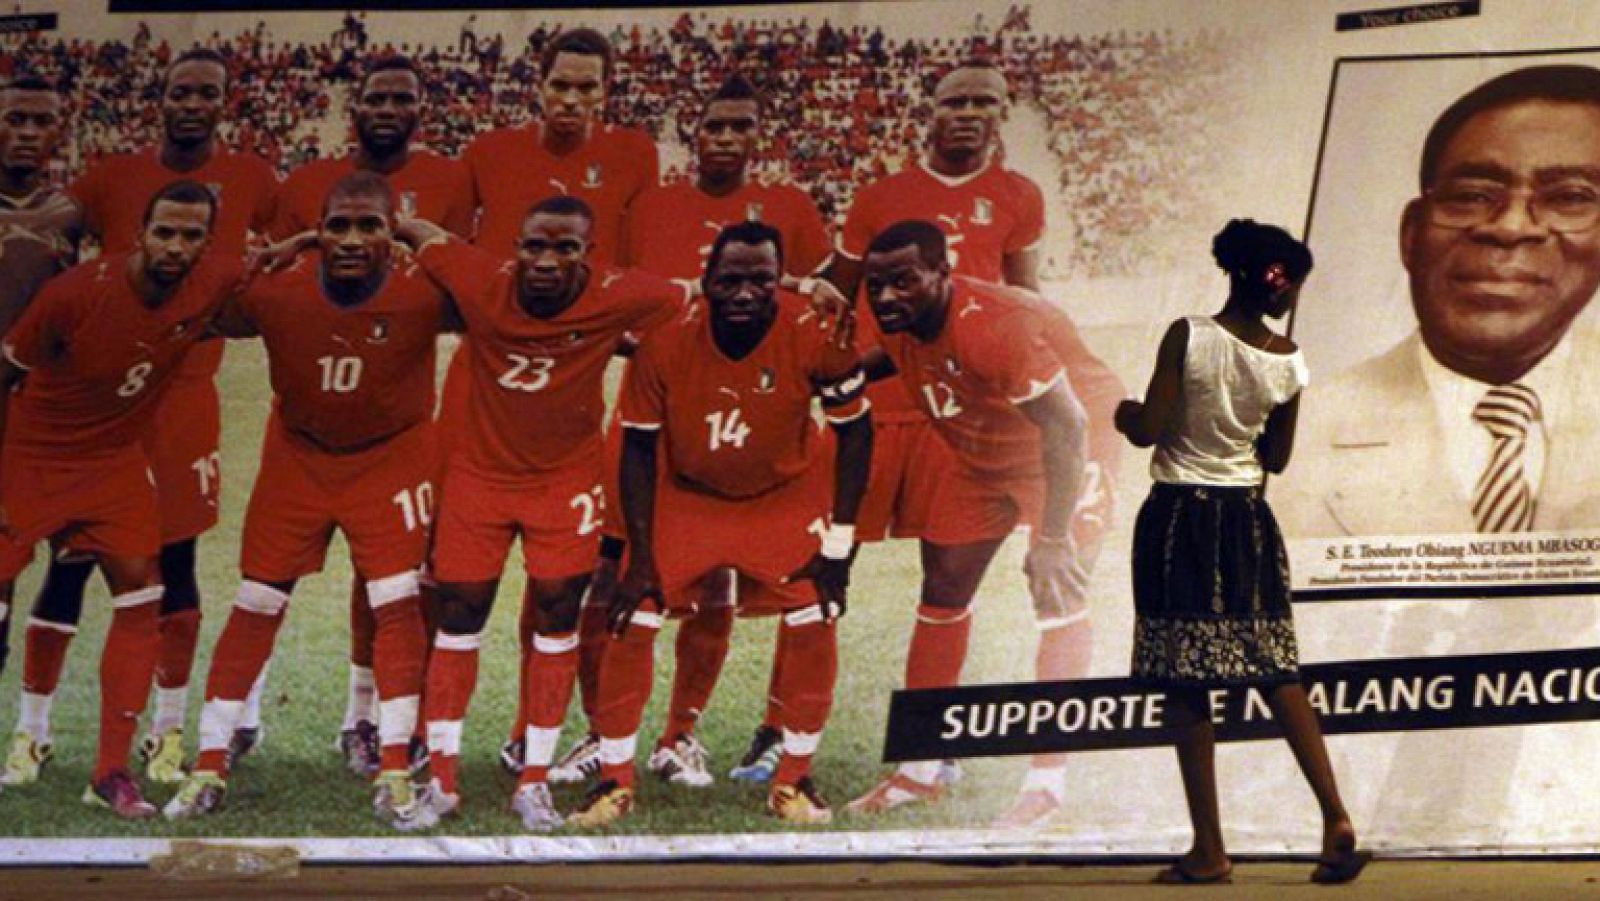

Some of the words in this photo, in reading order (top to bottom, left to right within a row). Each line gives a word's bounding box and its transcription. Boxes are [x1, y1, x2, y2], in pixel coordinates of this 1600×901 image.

[117, 362, 153, 397] 8
[317, 355, 364, 393] 10
[498, 353, 555, 392] 23
[922, 382, 963, 419] 12
[704, 408, 751, 451] 14
[1360, 542, 1413, 558] Teodoro
[1416, 542, 1465, 559] Obiang
[1467, 541, 1533, 556] NGUEMA
[940, 693, 1167, 740] SUPPORTE
[1208, 689, 1229, 725] E
[1243, 674, 1455, 722] NALANG
